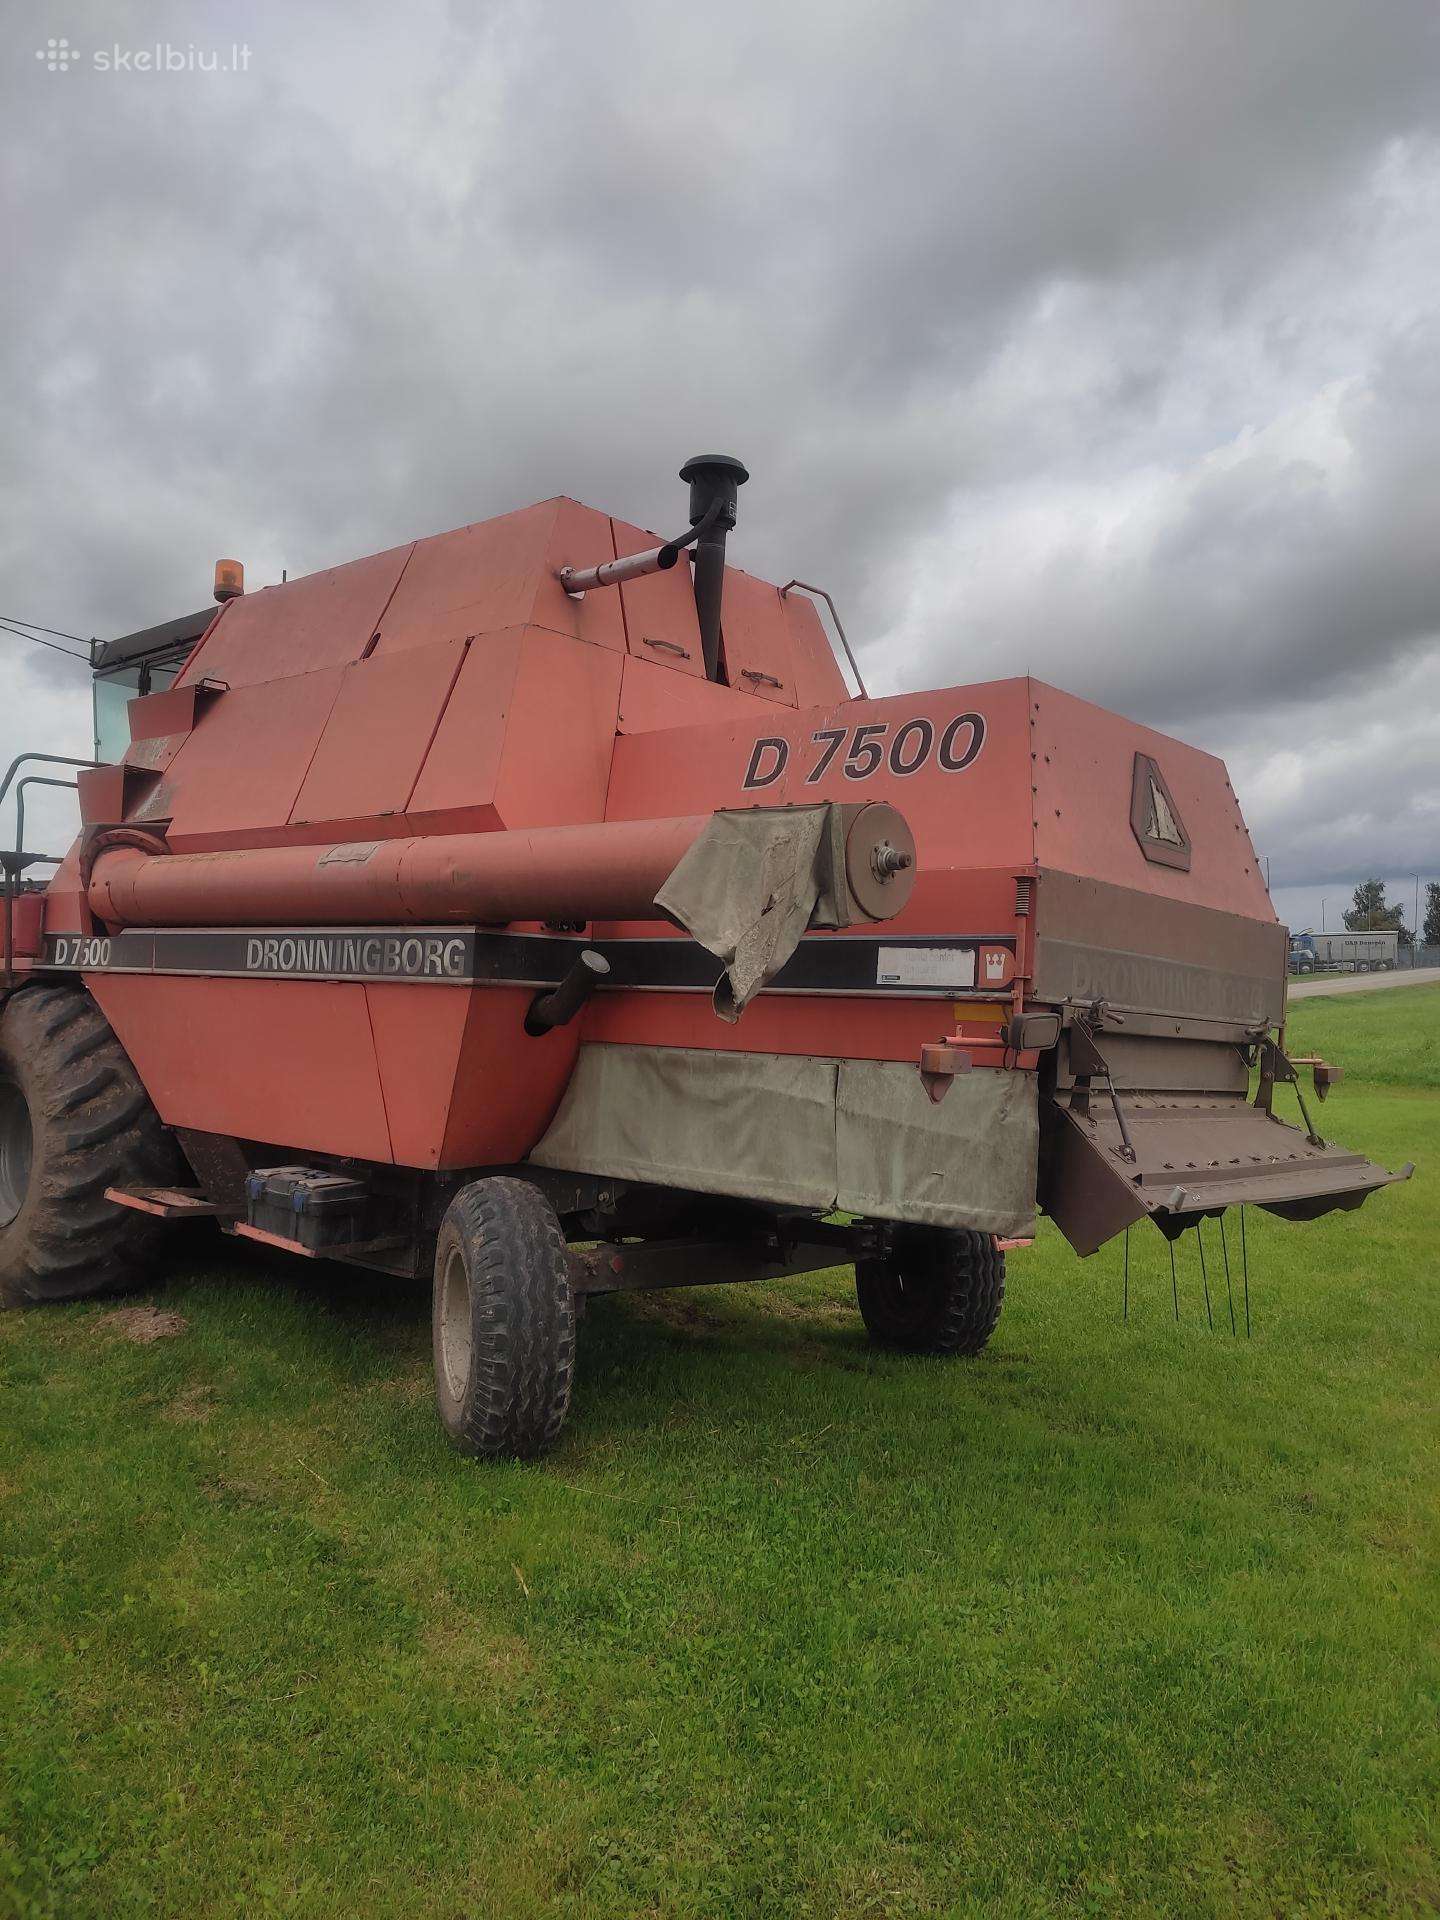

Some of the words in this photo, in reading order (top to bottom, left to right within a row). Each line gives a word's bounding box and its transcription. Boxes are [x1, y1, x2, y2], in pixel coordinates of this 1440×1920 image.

[741, 737, 790, 790] D
[804, 711, 987, 785] 7500
[54, 938, 68, 965] D
[246, 938, 466, 976] DRONNINGBORG
